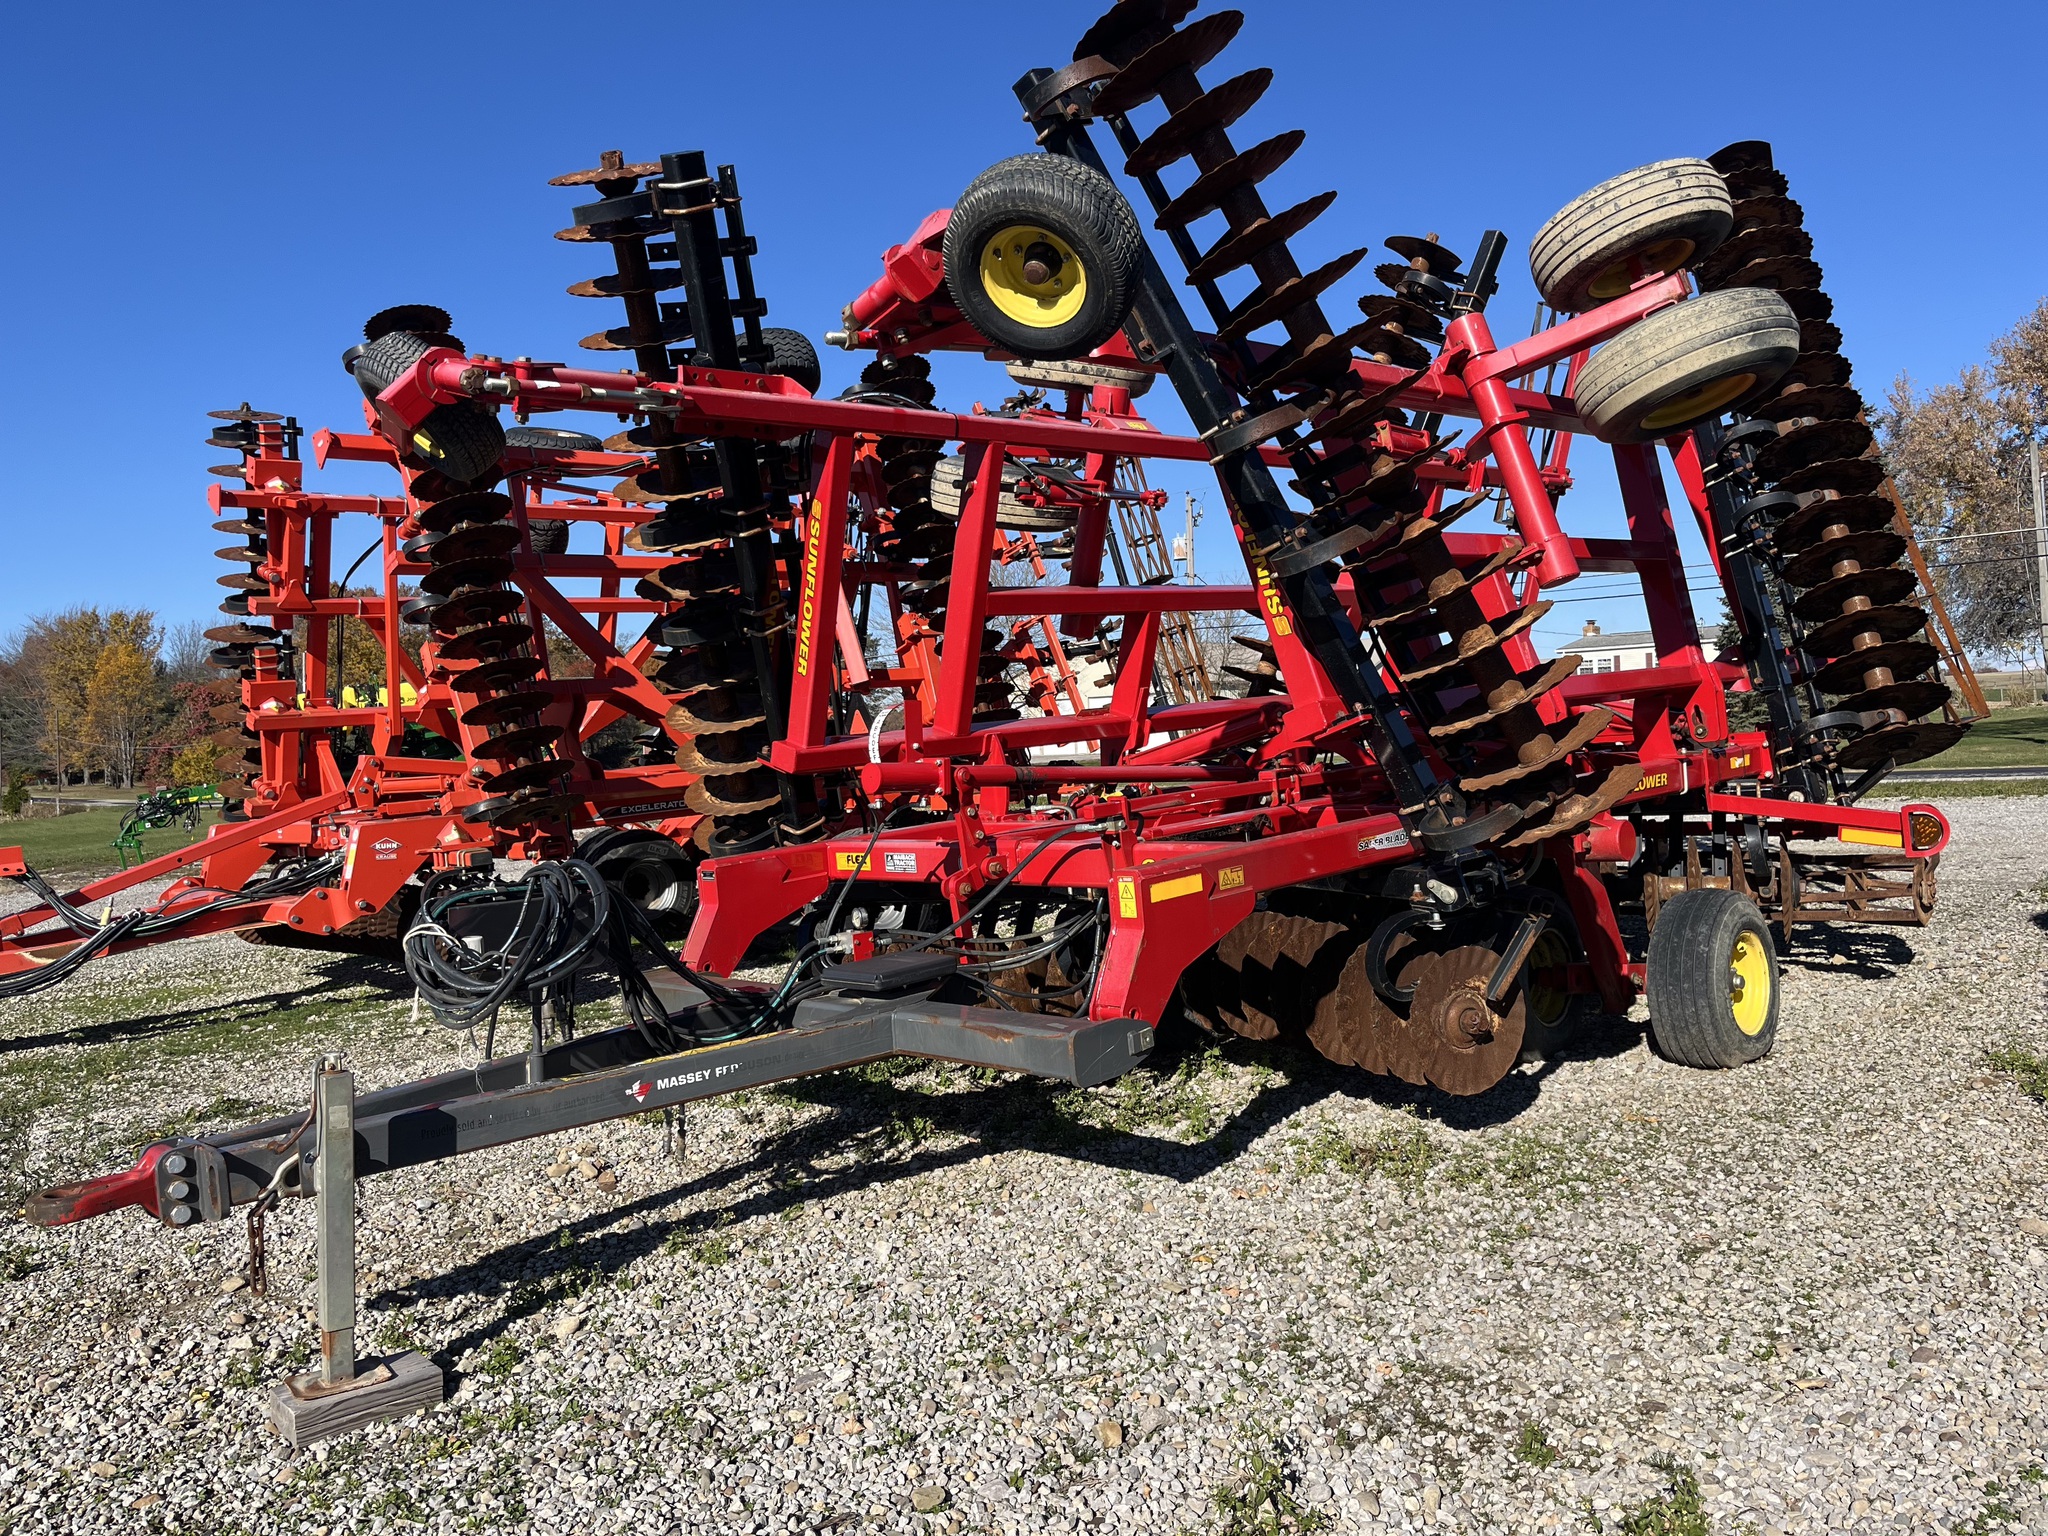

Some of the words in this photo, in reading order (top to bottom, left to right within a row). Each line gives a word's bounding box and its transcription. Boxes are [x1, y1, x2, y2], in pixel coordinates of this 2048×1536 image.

[797, 518, 821, 677] SUNFLOWER
[621, 800, 688, 814] EXCELERATO
[457, 1118, 475, 1133] sold
[656, 1068, 711, 1090] MASSEY
